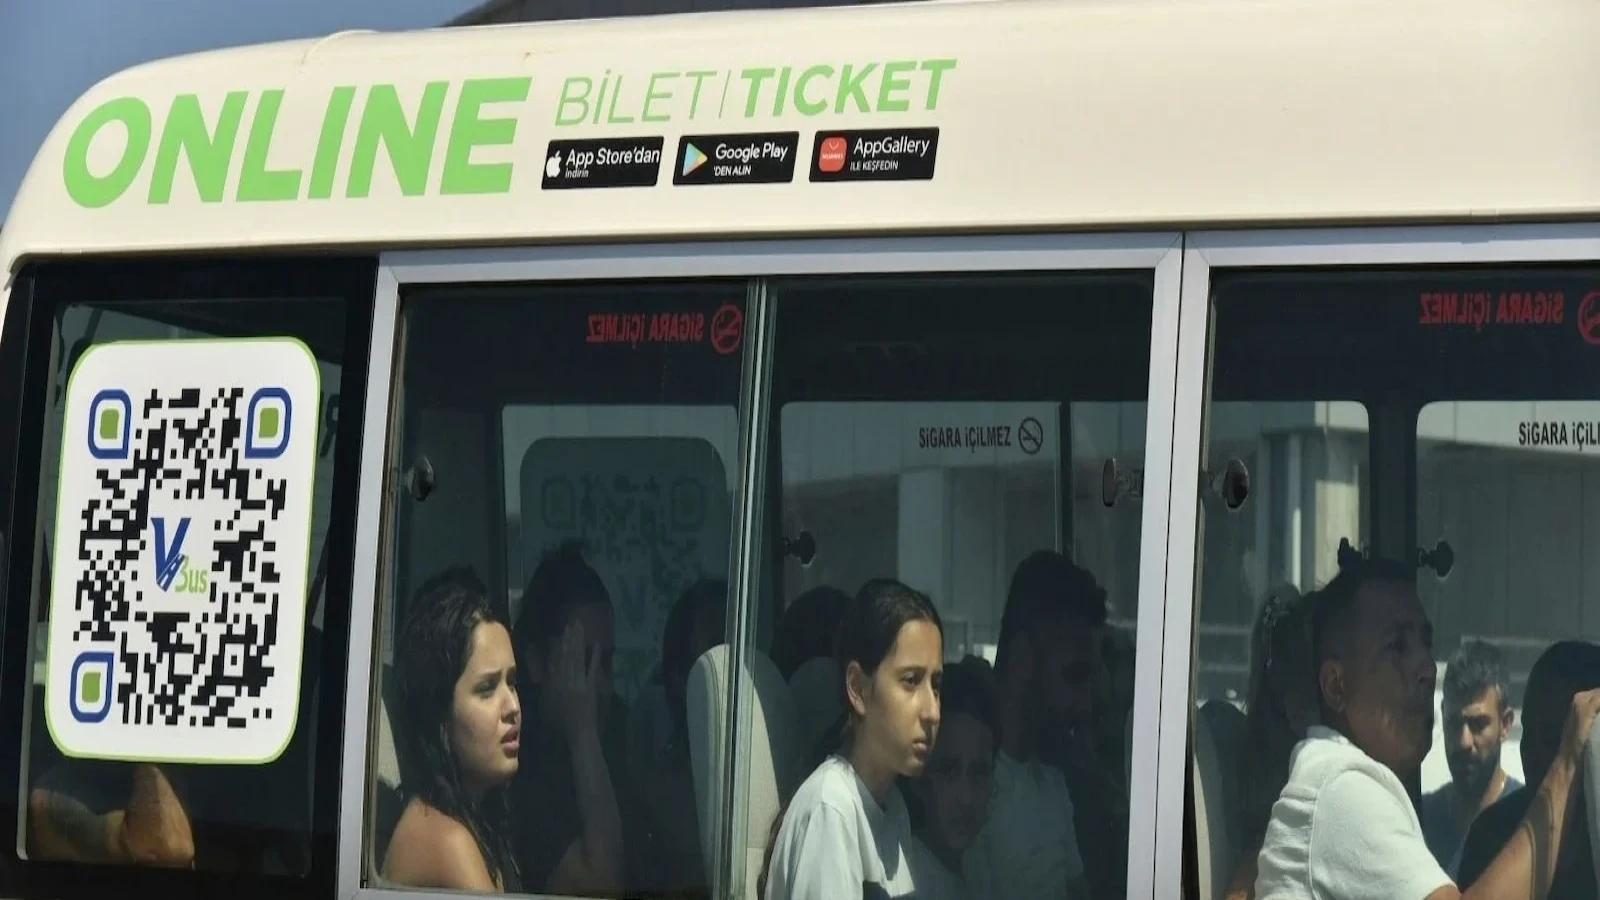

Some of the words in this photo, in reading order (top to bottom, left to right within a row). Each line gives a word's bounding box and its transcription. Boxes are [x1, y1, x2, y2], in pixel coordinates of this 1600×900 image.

[555, 69, 717, 126] BİLET
[740, 59, 957, 117] TICKET
[63, 76, 532, 209] ONLINE
[715, 143, 760, 163] Google
[762, 142, 788, 162] Play
[853, 136, 930, 158] AppGallery
[565, 148, 594, 169] App
[596, 146, 660, 165] Store'dan
[713, 165, 732, 177] 'DEN
[732, 165, 752, 176] ALIN
